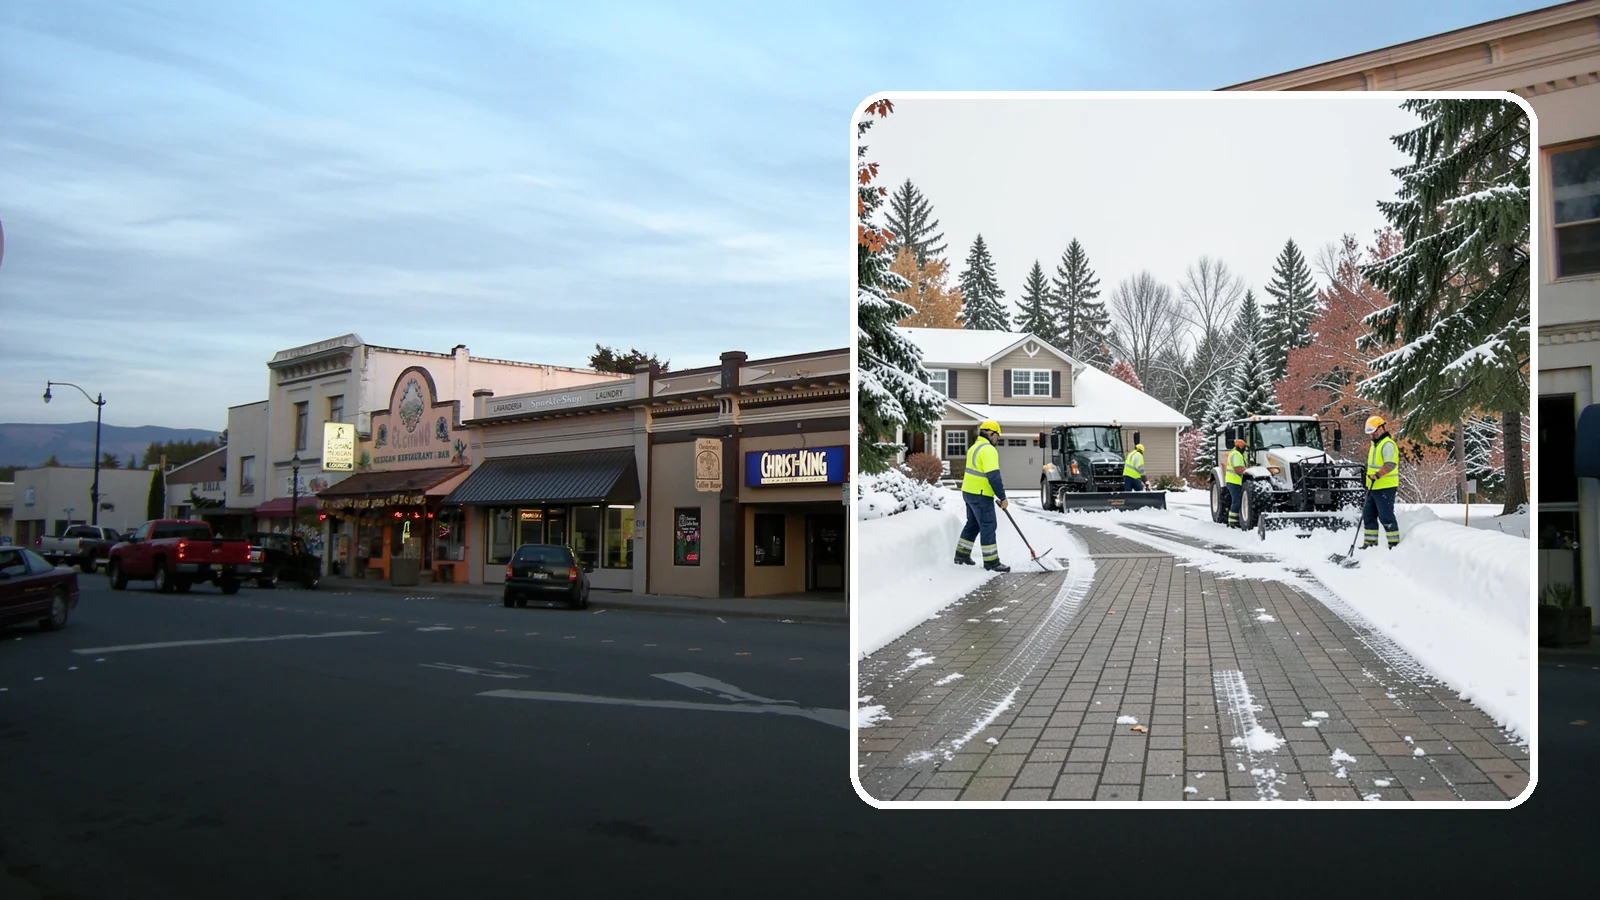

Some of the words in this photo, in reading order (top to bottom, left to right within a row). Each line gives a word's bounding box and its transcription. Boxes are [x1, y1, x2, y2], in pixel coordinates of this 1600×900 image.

[595, 389, 624, 400] LAUNDRY
[493, 402, 522, 413] LAVANDERIA
[373, 454, 396, 464] MEXICAN
[397, 451, 434, 462] RESTAURANT
[437, 450, 450, 459] BAR
[798, 449, 828, 477] KING
